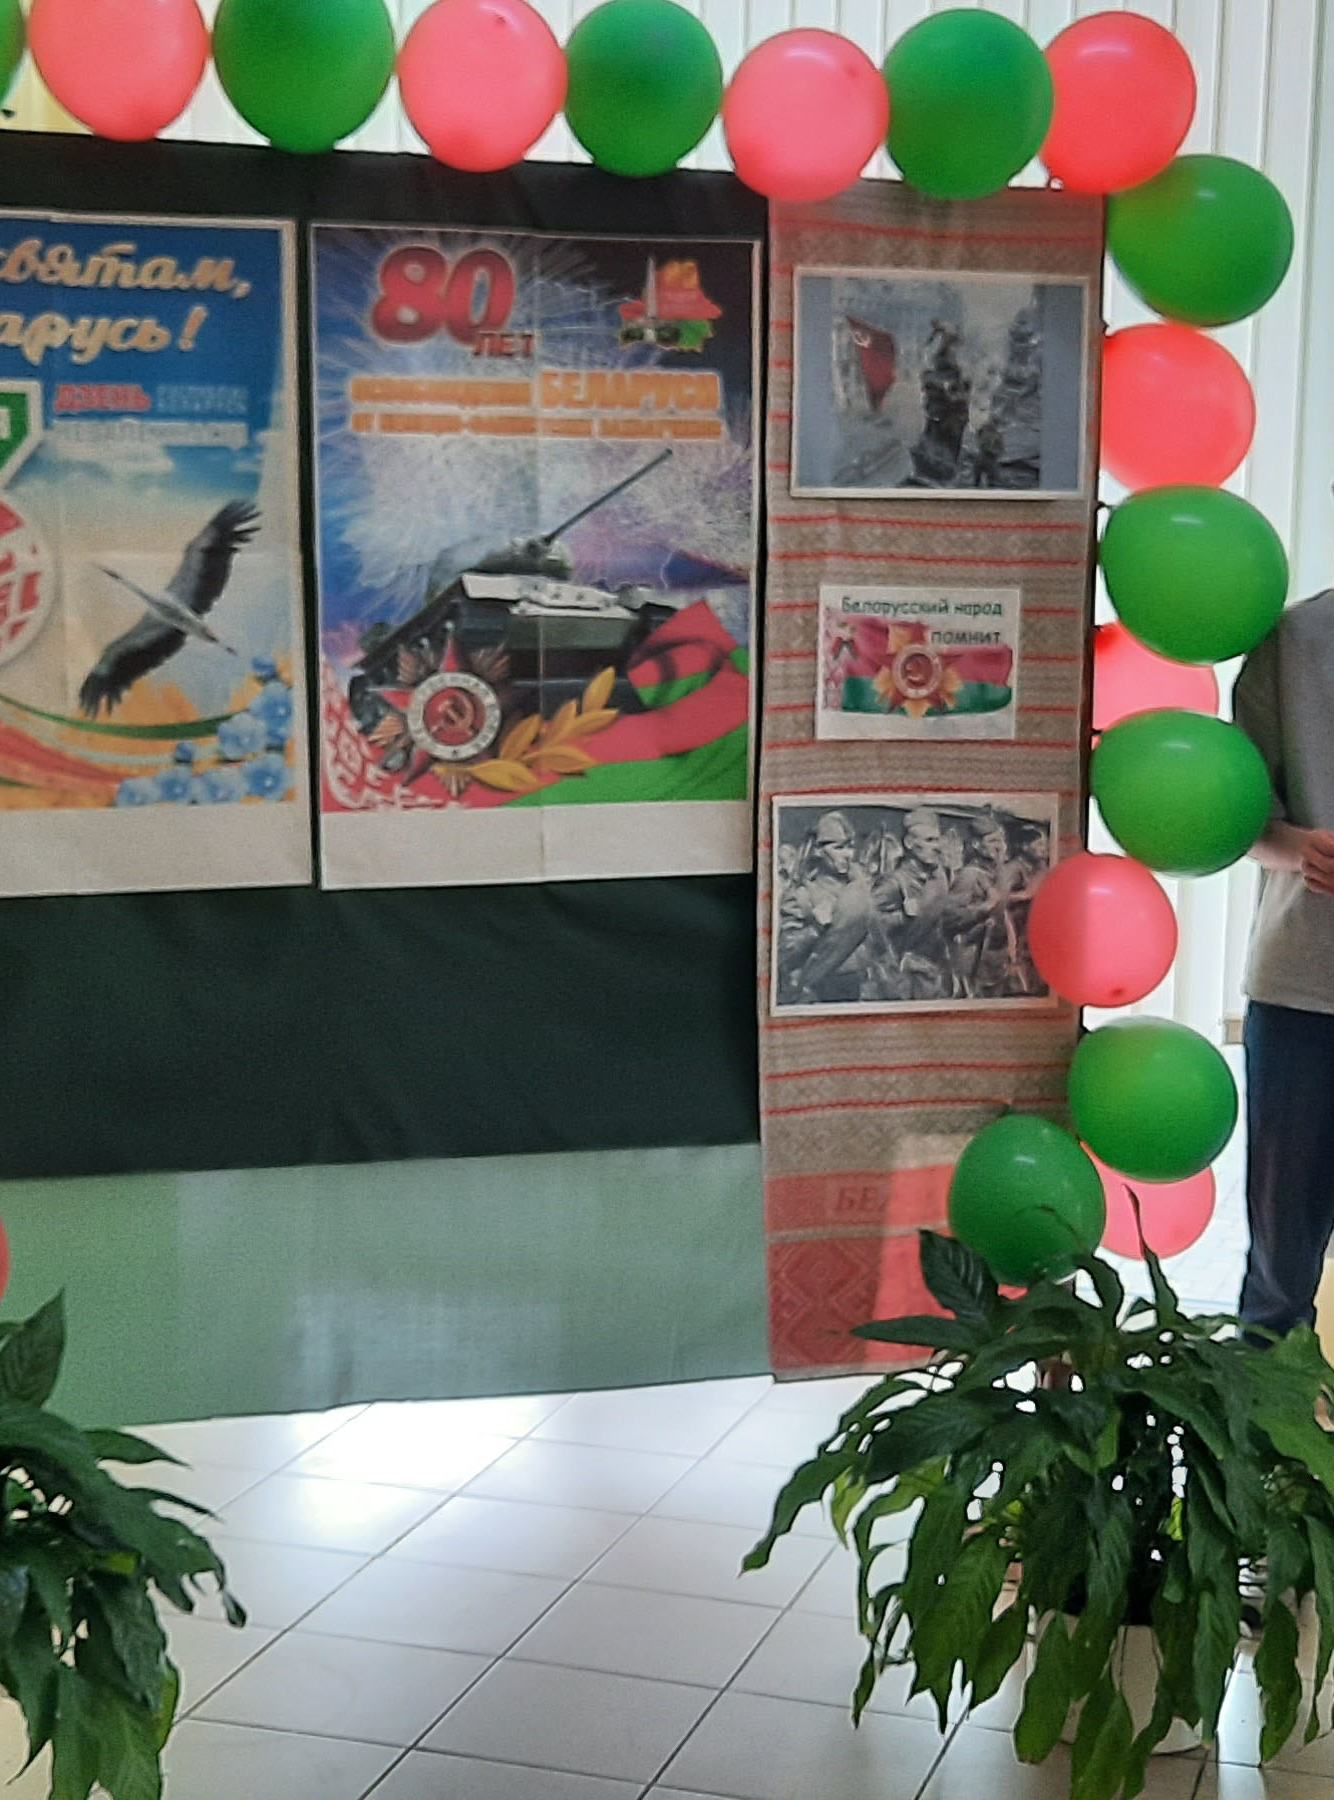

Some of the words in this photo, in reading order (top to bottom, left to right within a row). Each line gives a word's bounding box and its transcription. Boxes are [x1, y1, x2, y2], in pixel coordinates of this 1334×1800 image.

[372, 245, 516, 347] 80
[472, 330, 534, 359] ЛЕТ
[842, 596, 948, 617] Белорусский
[954, 602, 1004, 619] народ
